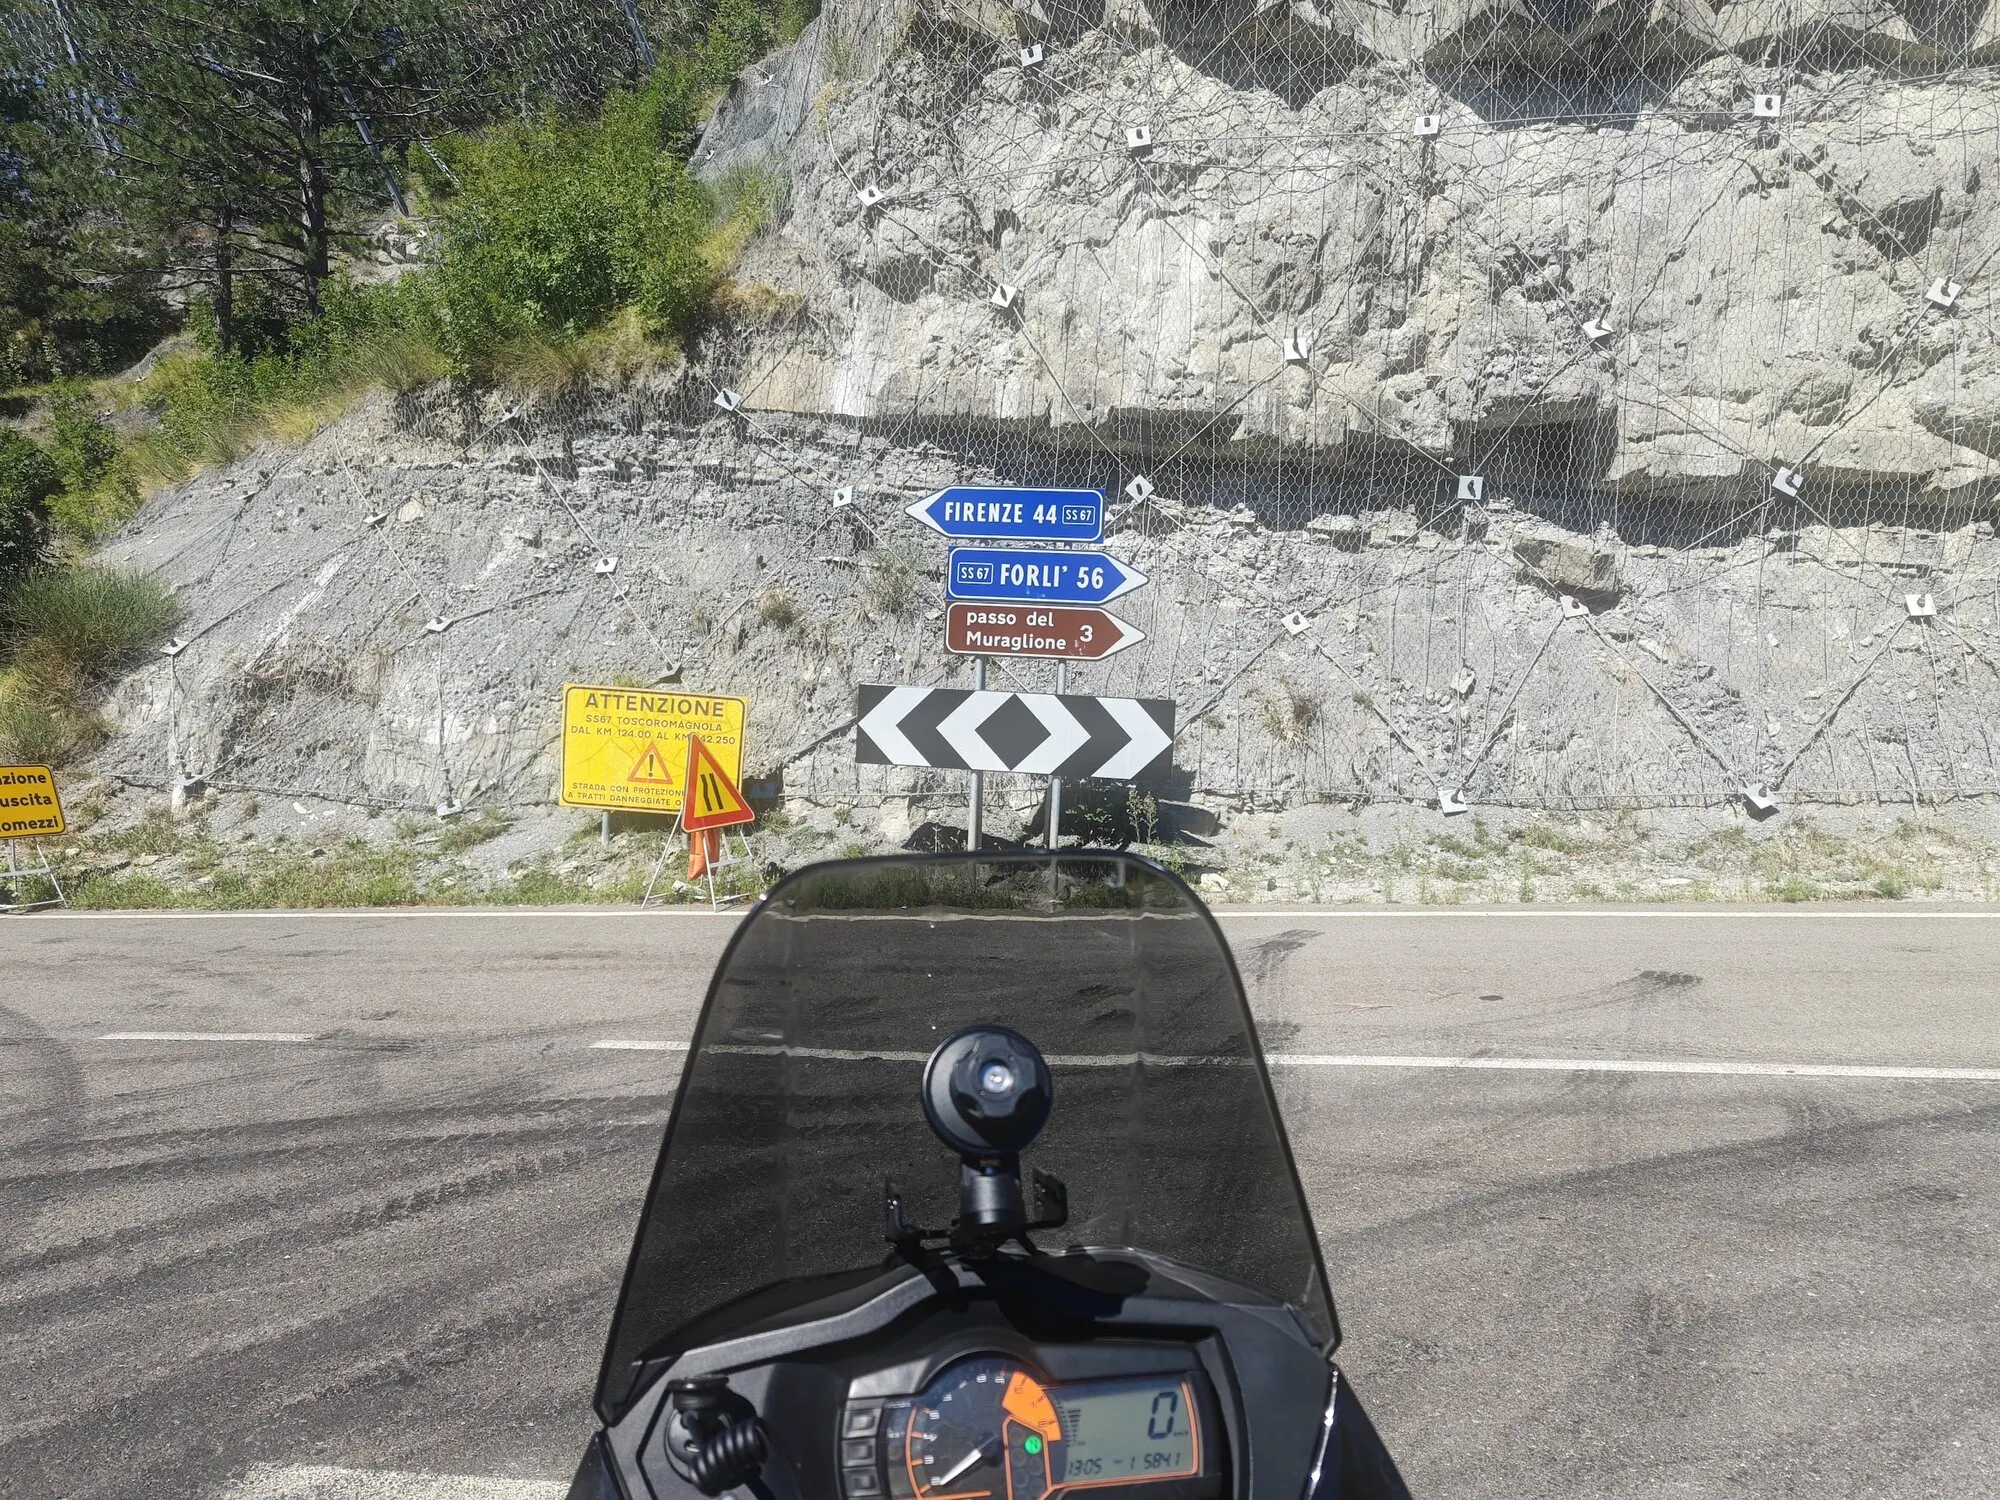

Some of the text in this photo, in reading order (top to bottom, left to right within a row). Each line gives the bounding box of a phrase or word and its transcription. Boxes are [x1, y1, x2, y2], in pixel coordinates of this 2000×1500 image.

[944, 501, 1023, 524] FIRENZE
[1032, 504, 1057, 525] 44
[1000, 563, 1067, 587] FORLI'
[1076, 566, 1104, 590] 56
[966, 611, 1054, 627] passo del
[966, 631, 1067, 650] Muraglione
[1079, 625, 1093, 643] 3
[585, 693, 724, 717] ATTENZIONE
[586, 714, 722, 732] SS67 TOSCOROMAGNOLA
[571, 725, 591, 735] DAL
[596, 727, 612, 737] KM
[617, 728, 651, 739] 124.00
[656, 731, 669, 741] AL
[699, 734, 736, 745] 42.250
[0, 772, 47, 785] zione
[572, 782, 606, 791] STRADA
[610, 785, 629, 793] CON
[0, 793, 52, 807] uscita
[577, 792, 606, 801] TRATTI
[610, 794, 671, 806] DANNEGGIATE
[0, 816, 58, 832] omezzi
[1147, 1391, 1178, 1440] 0
